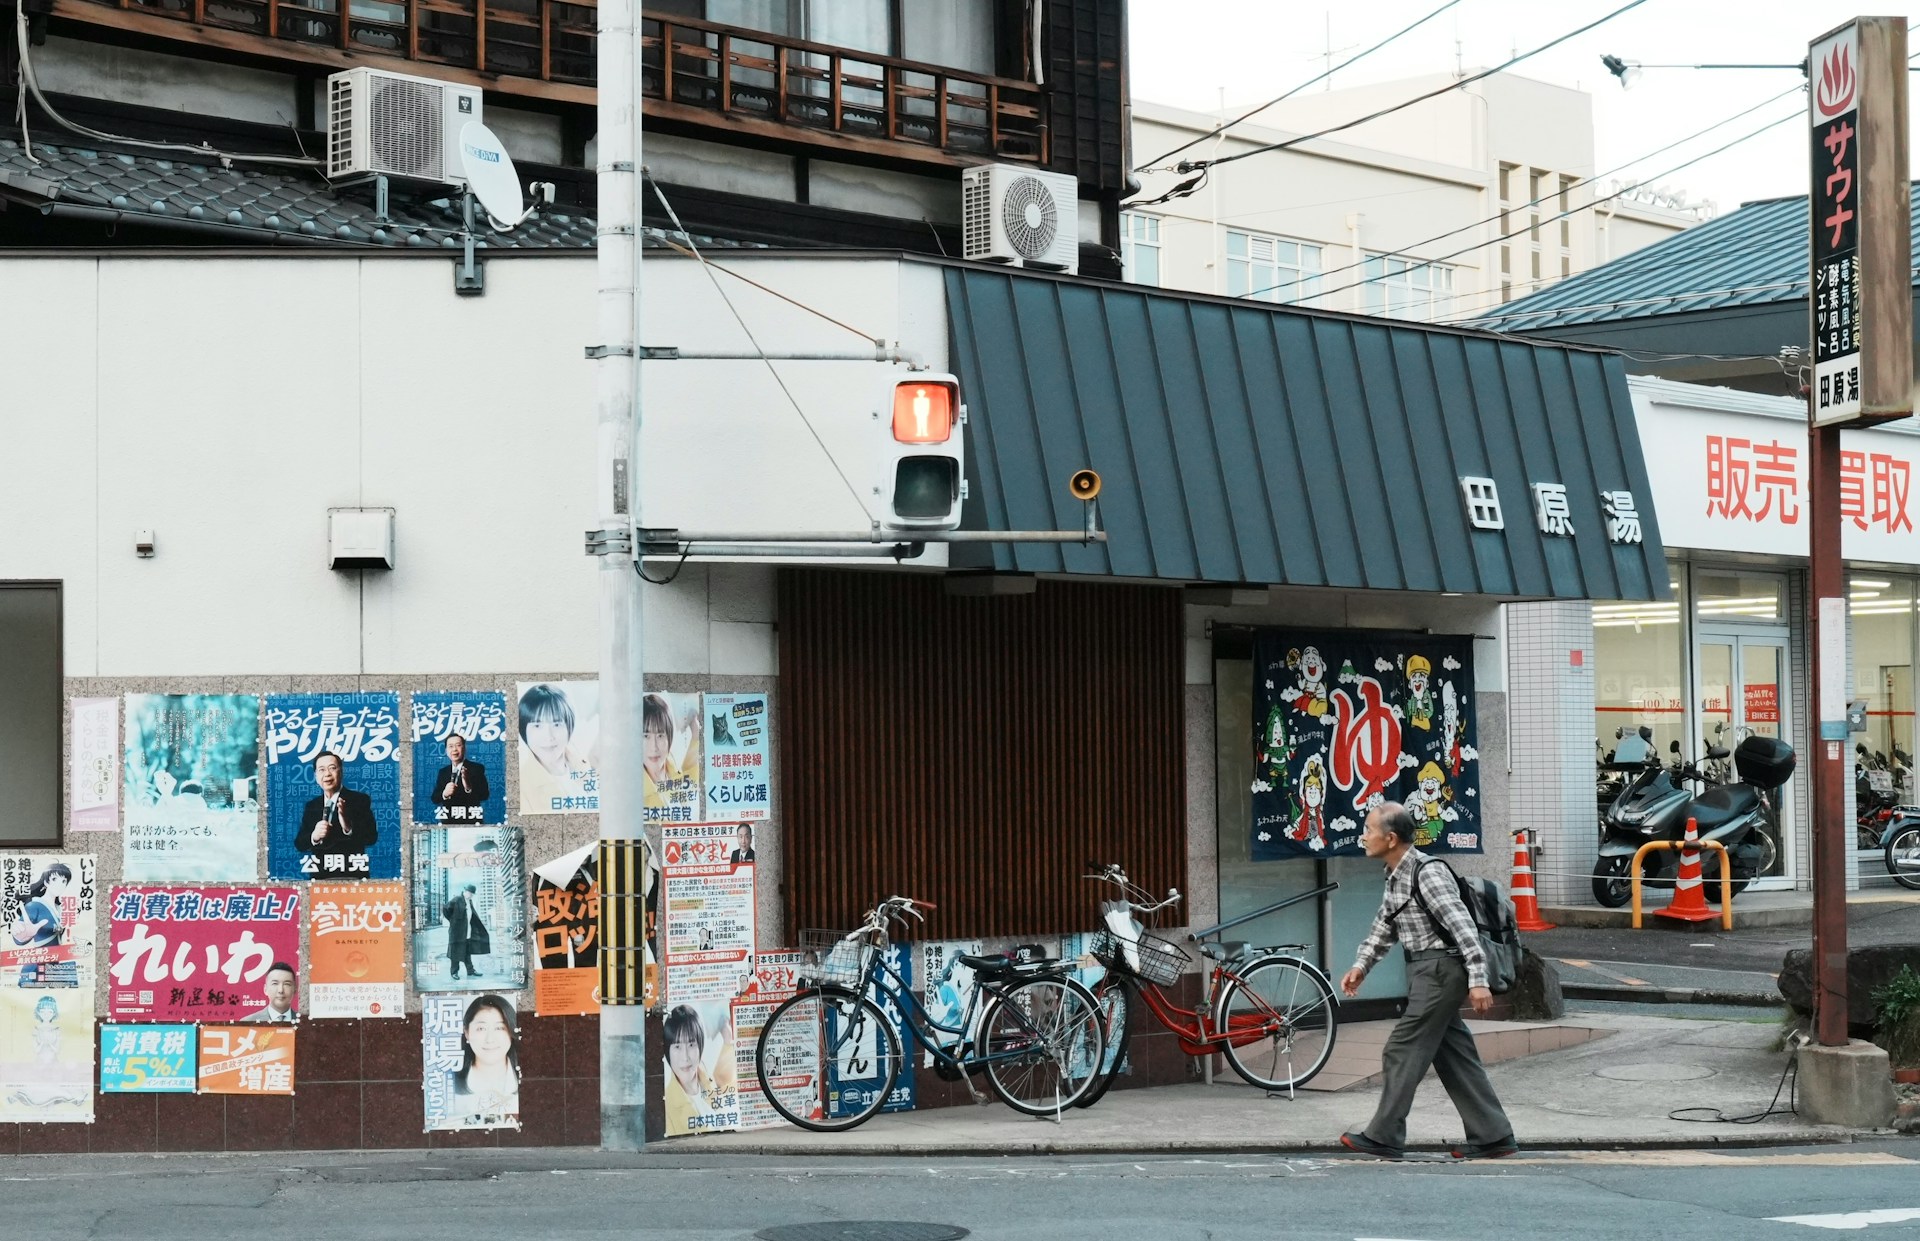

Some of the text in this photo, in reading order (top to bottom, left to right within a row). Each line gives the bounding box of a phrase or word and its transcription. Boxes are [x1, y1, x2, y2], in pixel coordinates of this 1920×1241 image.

[1825, 120, 1853, 248] サウナ
[1816, 265, 1827, 357] ジェット
[1828, 263, 1839, 354] 酵素風呂
[1841, 258, 1850, 350] 電気風呂
[1820, 366, 1858, 408] 田原湯
[1706, 435, 1913, 533] 販売買取
[1460, 476, 1642, 543] 田原湯
[266, 707, 399, 729] やると言ったら、
[412, 702, 506, 717] やると言ったら、
[412, 716, 506, 742] やり切る。
[266, 726, 400, 764] やり切る。
[1331, 676, 1402, 812] ゆ
[362, 763, 393, 779] 創設
[570, 768, 600, 780] ホンモ
[711, 753, 762, 767] 北陸新幹線
[348, 781, 394, 793] コメ安心
[583, 779, 600, 792] 改
[722, 770, 755, 780] 延伸よりも
[708, 783, 768, 803] くらし応援
[434, 807, 484, 820] 公明党
[643, 806, 692, 821] 日本共産党
[130, 824, 218, 837] 障害があっても、
[130, 838, 184, 850] 魂は健全。
[665, 827, 735, 838] 本来の日本を取り戻す
[300, 854, 369, 873] 公明党
[689, 839, 731, 862] やまと
[18, 858, 31, 894] 絶対に
[80, 858, 93, 911] いじめは
[3, 858, 17, 934] ゆるさない!
[113, 891, 298, 921] 消費税は廃止!
[61, 896, 76, 942] 犯罪!
[311, 901, 402, 937] 参政党
[110, 924, 275, 985] れいわ
[537, 925, 599, 958] ロッ
[168, 986, 226, 1007] 新選組
[112, 1031, 188, 1055] 消費税
[203, 1028, 257, 1058] コメ
[119, 1056, 186, 1089] 5%!
[239, 1062, 292, 1092] 増産
[424, 998, 465, 1128] 堀場さち子
[711, 1093, 737, 1110] 改革
[688, 1112, 739, 1130] 日本共産党
